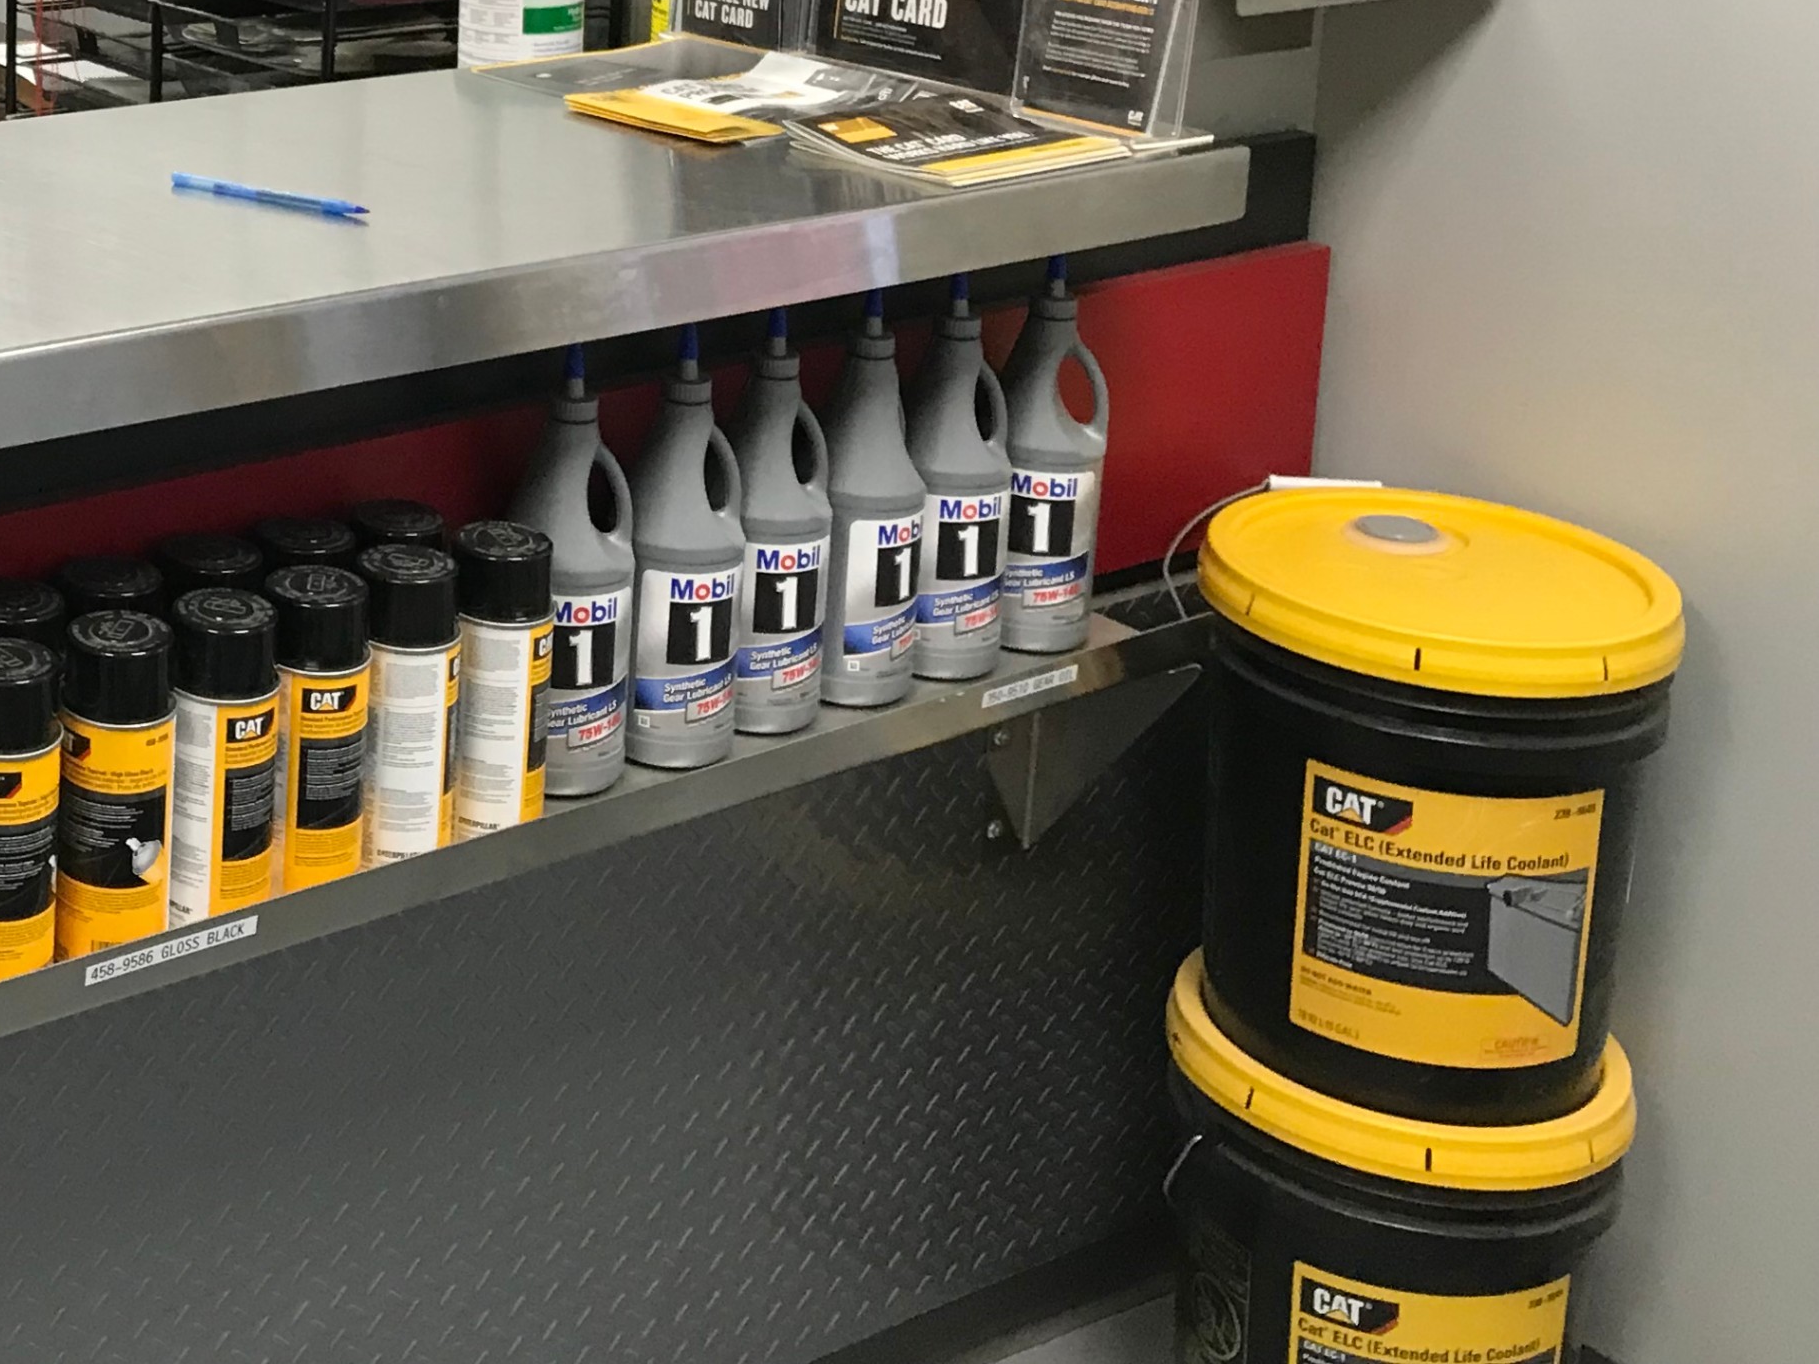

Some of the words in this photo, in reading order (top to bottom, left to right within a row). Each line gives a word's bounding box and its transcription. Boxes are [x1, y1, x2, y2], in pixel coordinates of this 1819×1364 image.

[694, 0, 718, 21] CAT
[721, 4, 754, 28] CARD
[1011, 472, 1078, 498] Mobil
[940, 496, 1002, 520] Mobil
[1027, 502, 1052, 553] 1
[756, 546, 821, 571] Mobil
[958, 525, 979, 578] 1
[895, 547, 912, 601] 1
[1023, 575, 1063, 587] Lubricant
[671, 578, 734, 601] Mobil
[934, 593, 974, 607] Synthetic
[556, 597, 617, 624] Mobil
[776, 576, 798, 630] 1
[933, 606, 954, 617] Gear
[690, 606, 713, 662] 1
[569, 629, 593, 686] 1
[749, 660, 771, 671] Gear
[772, 650, 809, 669] Lubricant
[750, 646, 792, 661] Synthetic
[663, 691, 684, 703] Gear
[664, 678, 707, 693] Synthetic
[310, 692, 343, 711] CAT
[235, 717, 265, 740] CAT
[568, 709, 607, 726] Lubricant
[1326, 786, 1384, 826] CAT
[1310, 818, 1338, 840] Cat
[1344, 830, 1374, 851] ELC
[1379, 839, 1466, 868] (Extended
[1471, 854, 1501, 871] Life
[1507, 853, 1570, 872] Coolant)
[91, 950, 154, 980] 458-9586
[161, 936, 200, 959] GLOSS
[206, 922, 245, 945] BLACK
[1313, 1287, 1371, 1326] CAT
[1298, 1318, 1328, 1338] Cat
[1333, 1330, 1363, 1351] ELC
[1367, 1337, 1449, 1364] (Extended
[1454, 1347, 1481, 1363] Life
[1487, 1338, 1541, 1362] Coolant)
